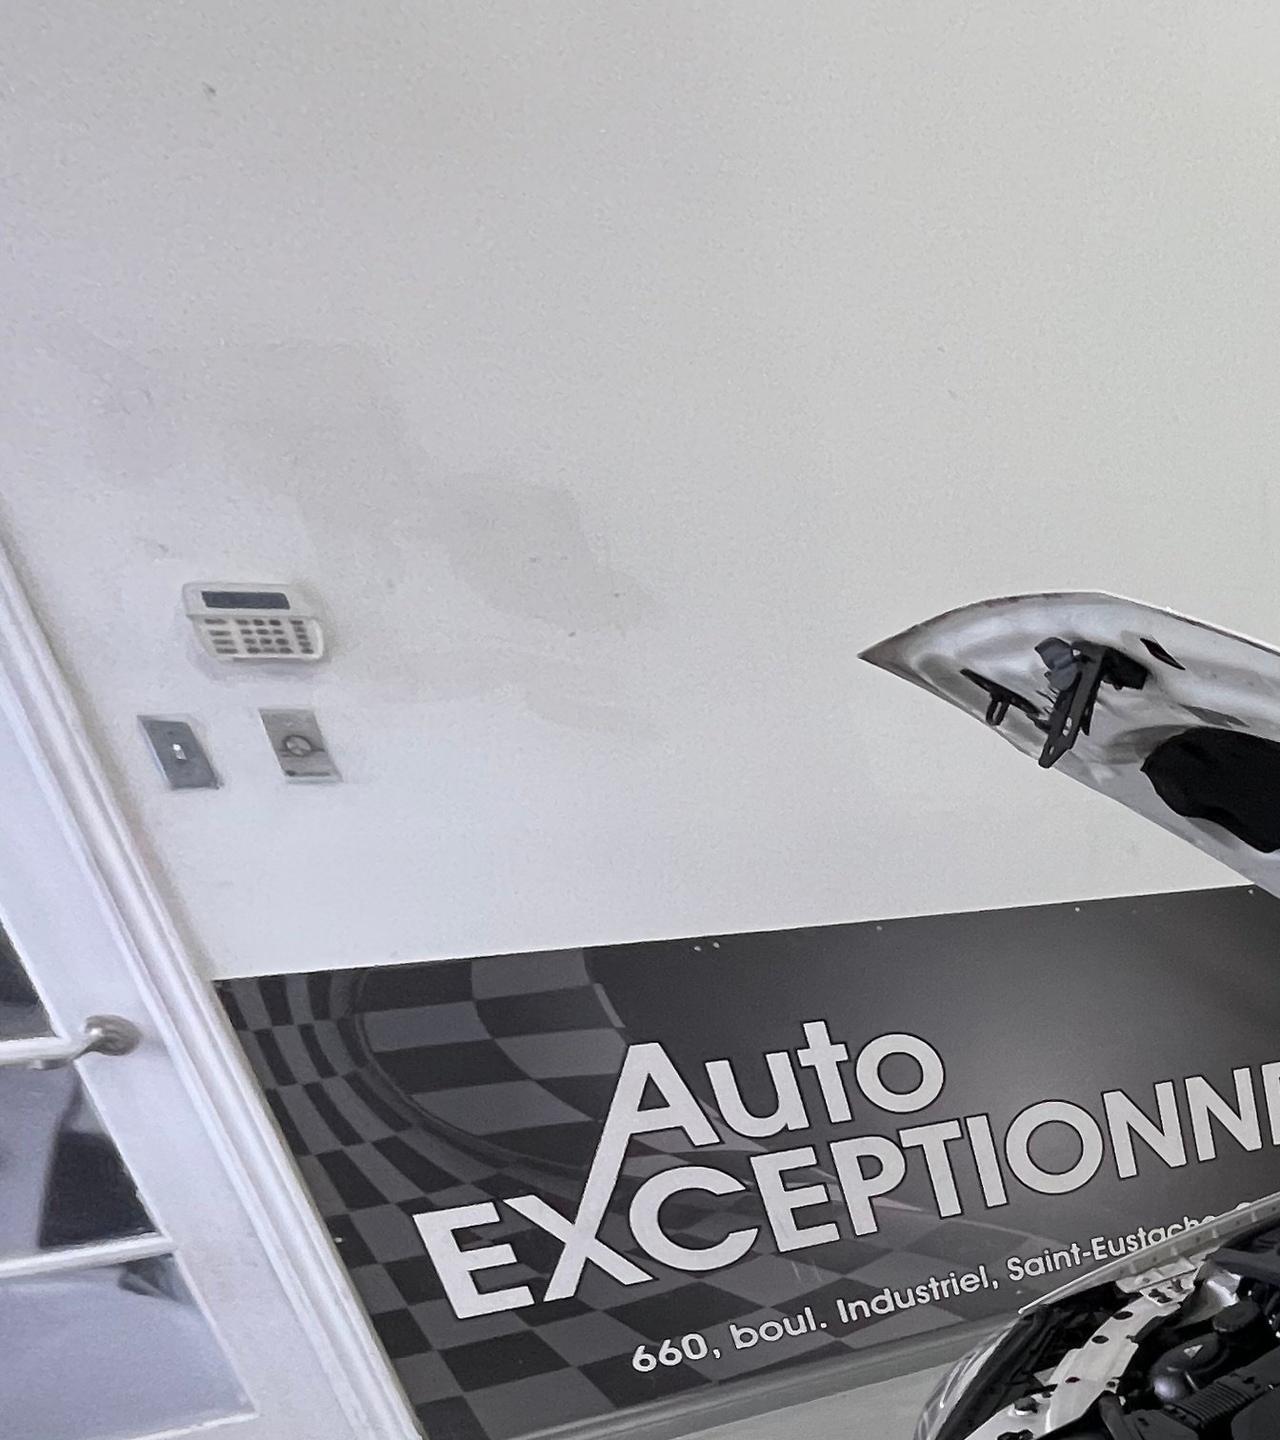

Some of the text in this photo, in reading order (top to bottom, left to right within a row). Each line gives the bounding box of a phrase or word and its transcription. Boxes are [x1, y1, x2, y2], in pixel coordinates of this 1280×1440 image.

[588, 1019, 945, 1162] Auto
[631, 1332, 722, 1373] 660,
[729, 1306, 828, 1351] boul.
[836, 1265, 1000, 1324] Industriel,
